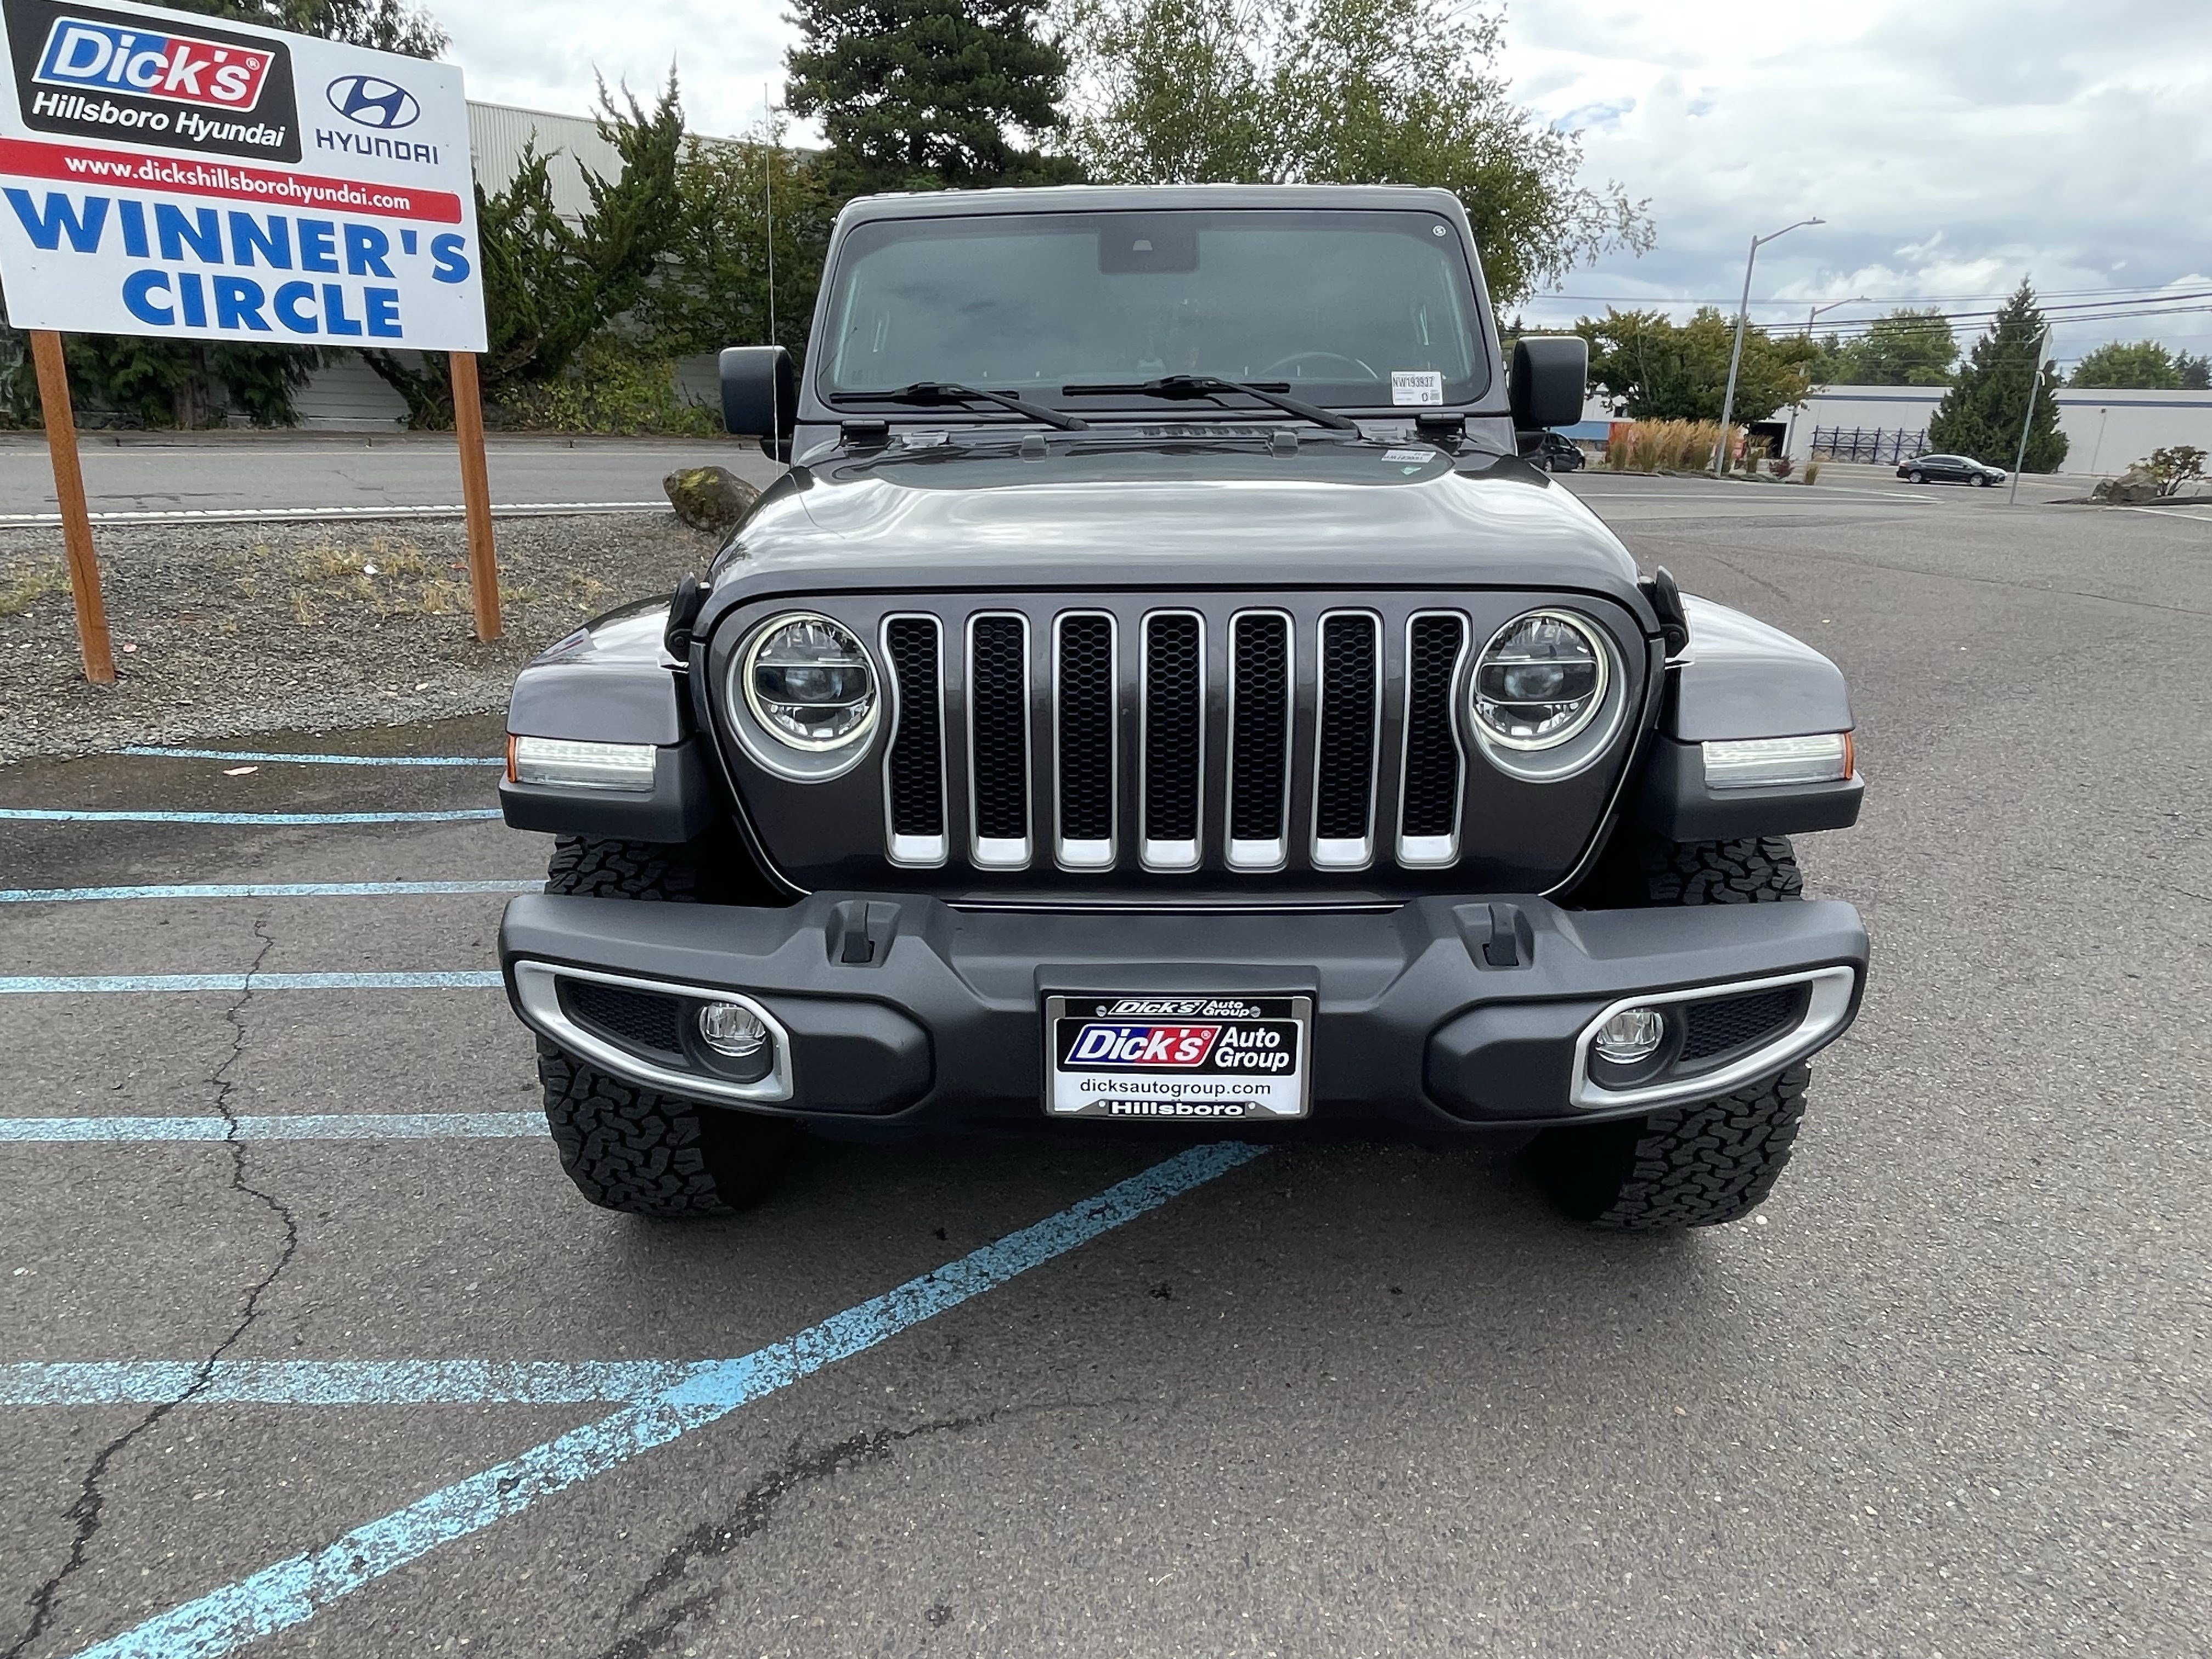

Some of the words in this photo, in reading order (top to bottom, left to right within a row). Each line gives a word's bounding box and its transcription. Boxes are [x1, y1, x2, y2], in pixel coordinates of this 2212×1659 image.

[52, 27, 251, 101] Dick's
[32, 92, 170, 131] Hillsboro
[176, 112, 285, 148] Hyundai
[316, 129, 439, 165] HYUNDAI
[64, 155, 410, 211] www.dickshillsborohyundai.com
[2, 187, 471, 284] WINNER'S
[122, 269, 403, 338] CIRCLE
[1115, 1002, 1195, 1013] Dick's
[1207, 1000, 1244, 1008] Auto
[1203, 1007, 1250, 1018] Group
[1075, 1028, 1203, 1061] Dick's
[1219, 1026, 1280, 1048] Auto
[1215, 1047, 1289, 1071] Group
[1080, 1079, 1271, 1097] dicksautogroup.com
[1111, 1101, 1243, 1116] Hillsboro
